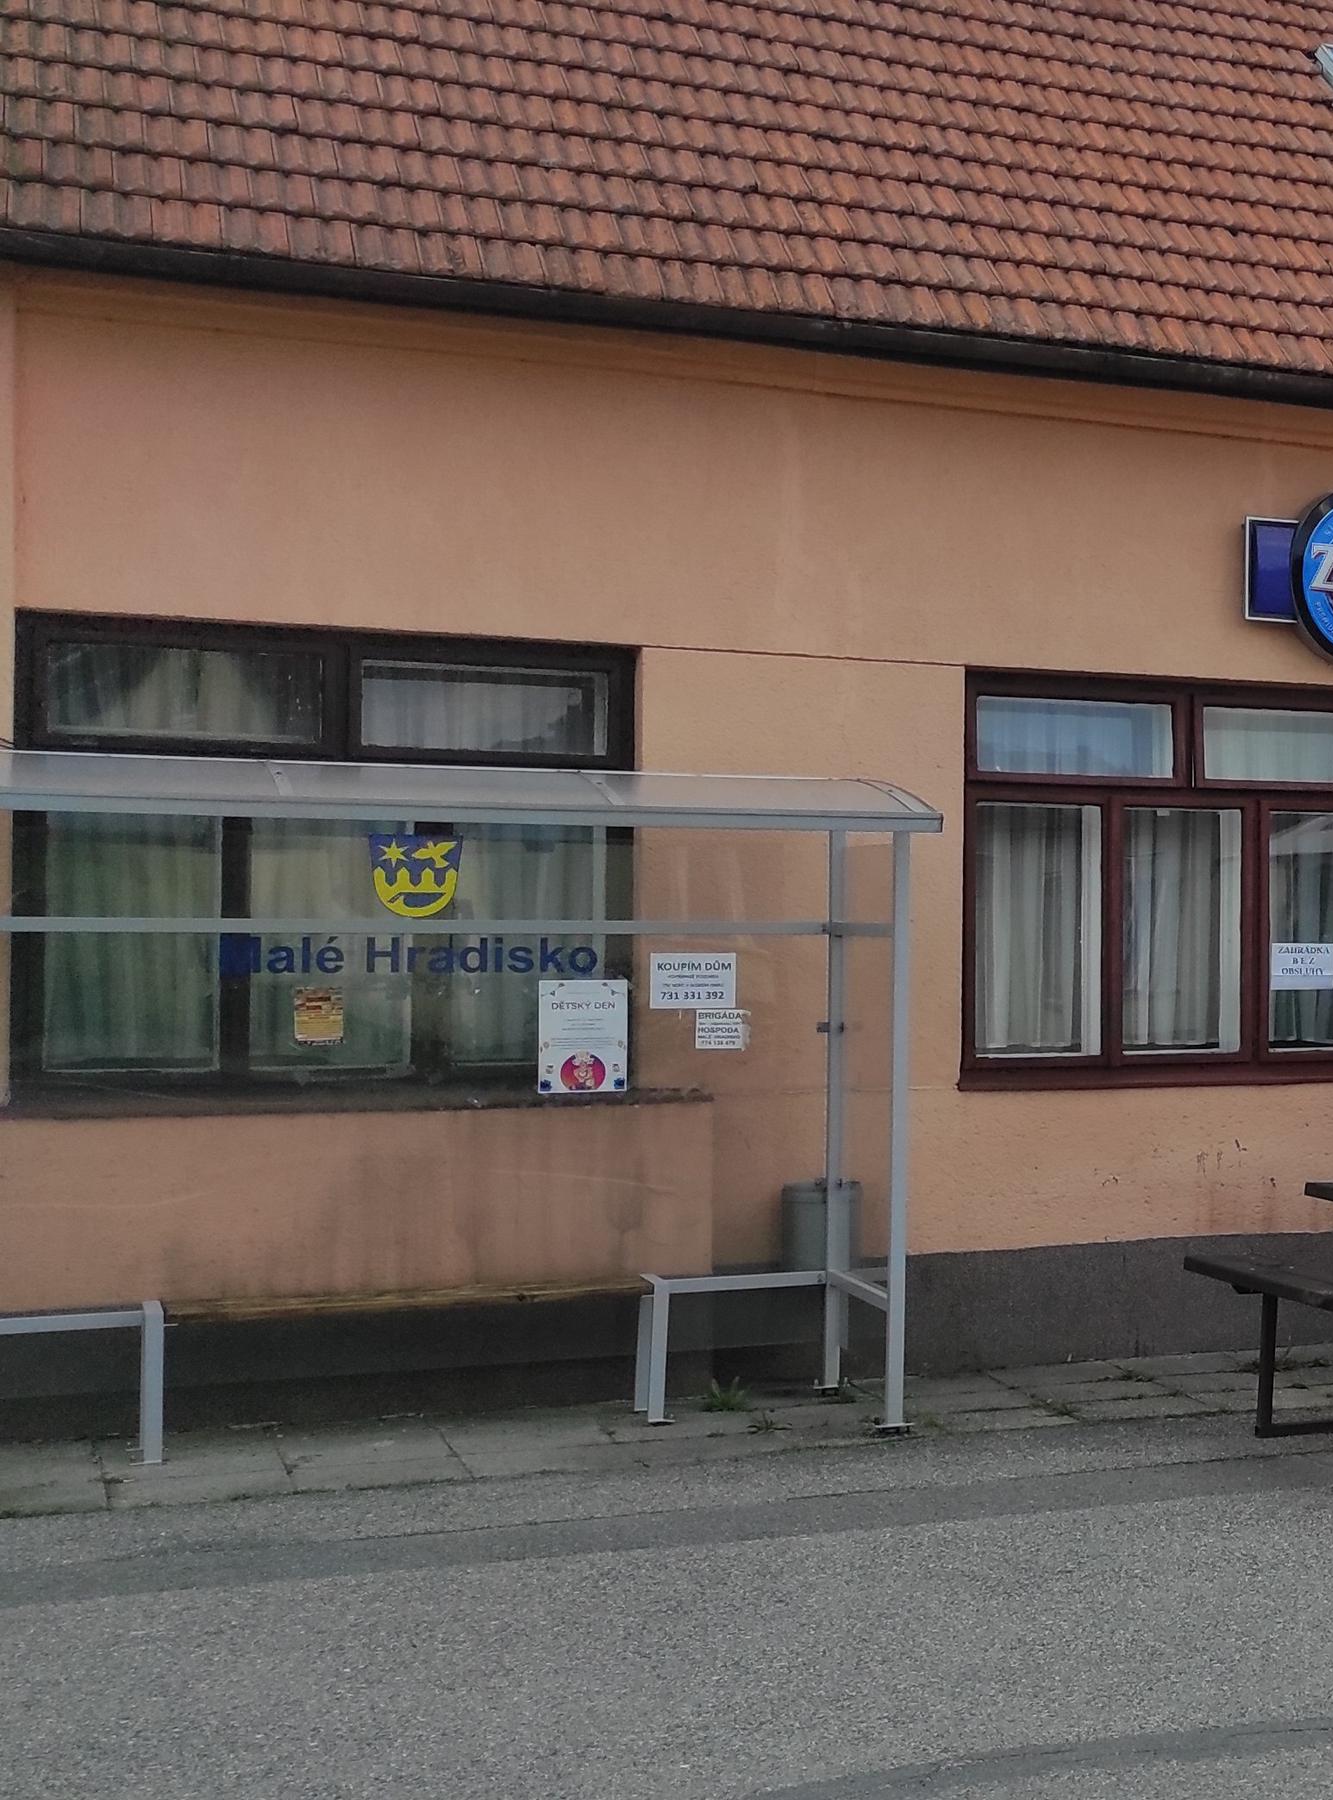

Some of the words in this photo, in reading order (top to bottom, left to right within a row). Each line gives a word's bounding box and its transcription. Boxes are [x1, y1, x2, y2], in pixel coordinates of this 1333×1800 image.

[220, 935, 345, 974] alé
[366, 936, 598, 973] Hradisko
[657, 961, 702, 971] KOUPÍM
[705, 960, 732, 971] DŮM
[661, 991, 680, 1000] 731
[683, 991, 702, 1000] 331
[705, 991, 725, 1000] 392
[594, 1001, 616, 1010] DEN
[698, 1011, 742, 1020] BRIGÁDA
[698, 1026, 740, 1034] HOSPODA
